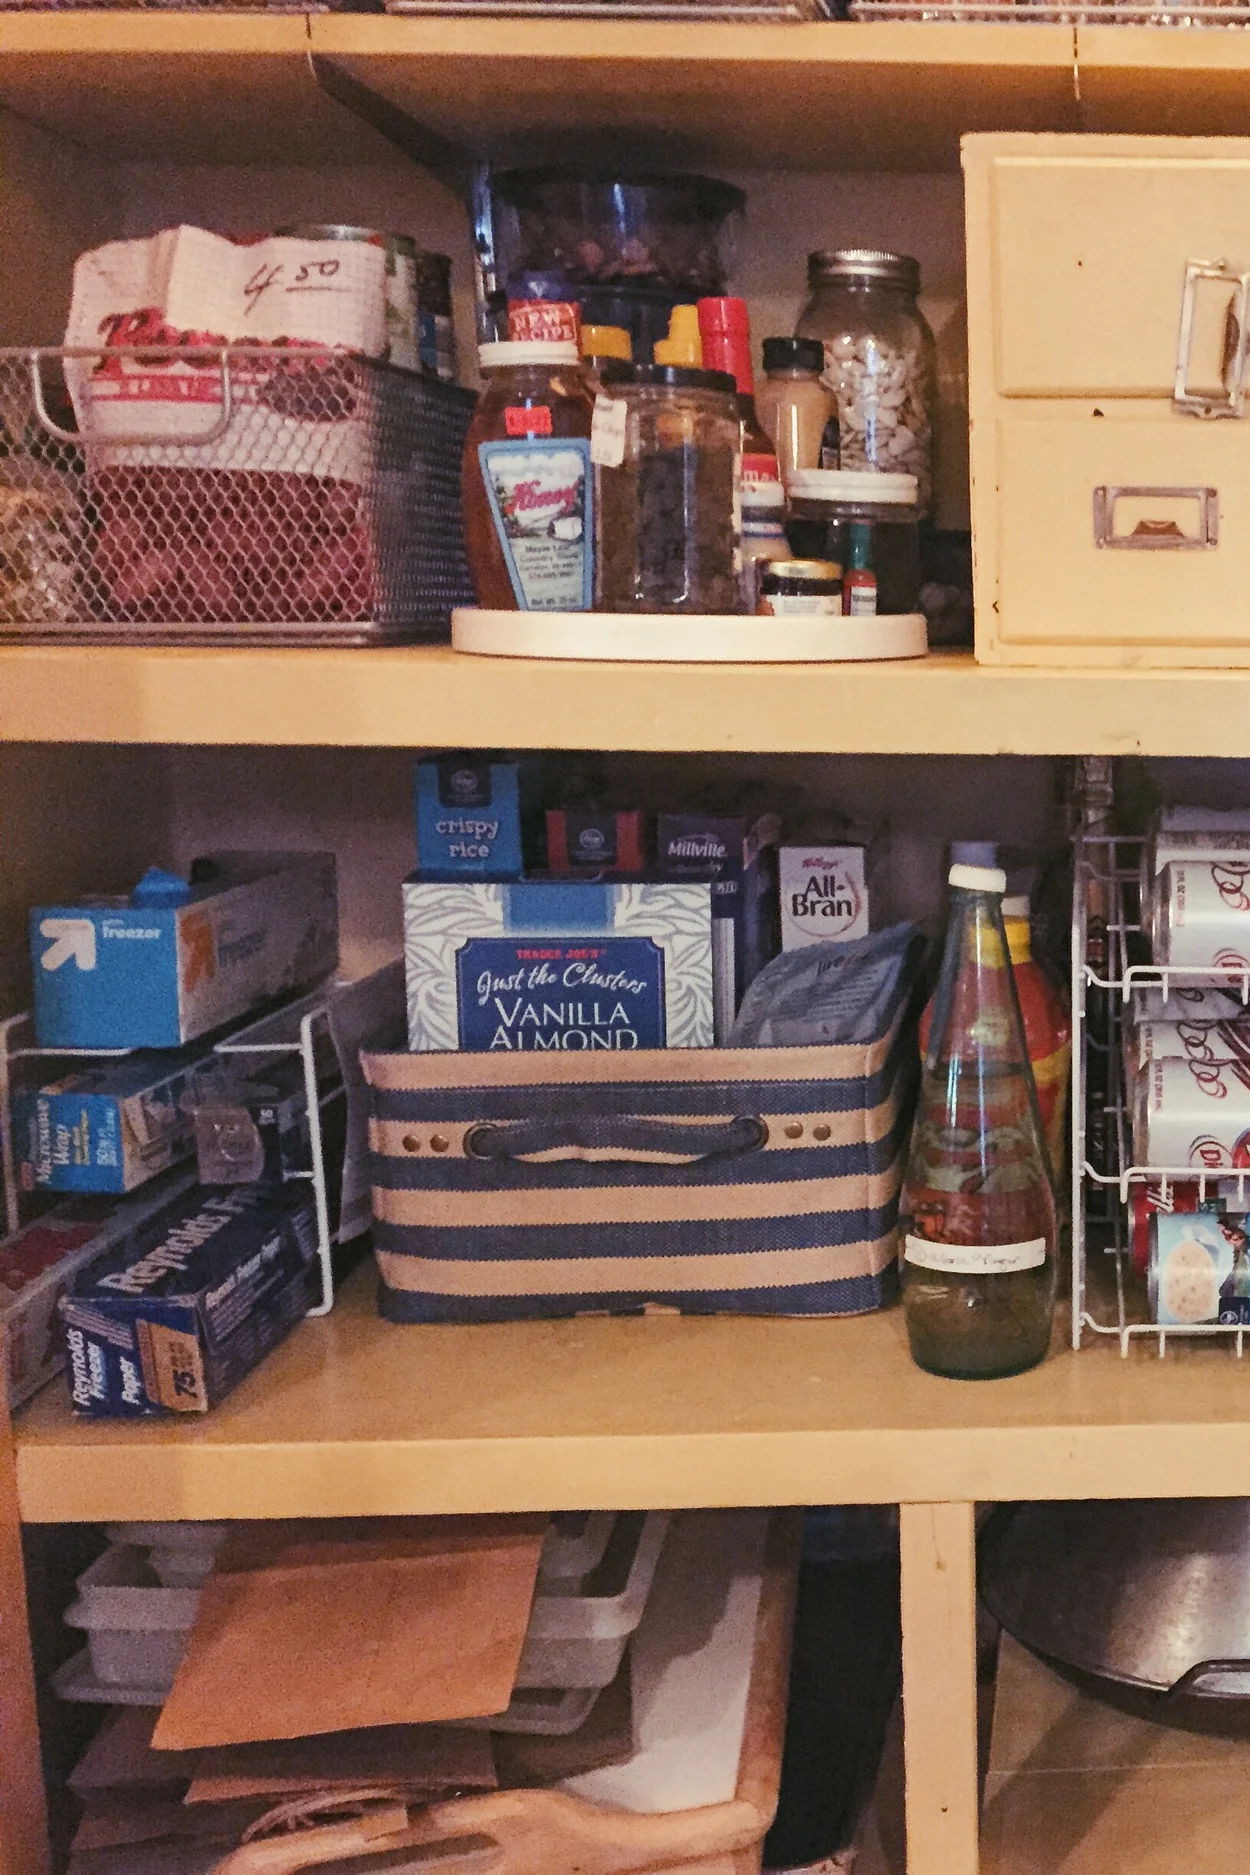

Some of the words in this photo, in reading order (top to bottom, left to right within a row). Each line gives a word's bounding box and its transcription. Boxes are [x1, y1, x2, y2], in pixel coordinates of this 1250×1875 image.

[435, 817, 499, 840] crispy
[450, 841, 490, 858] rice
[667, 838, 727, 858] Millville
[791, 893, 852, 917] Bran
[102, 925, 162, 940] freezer
[476, 966, 525, 1007] Just
[527, 961, 558, 990] the
[562, 961, 648, 995] Clusters
[494, 996, 631, 1028] VANILLA
[488, 1024, 639, 1051] ALMOND
[95, 1213, 232, 1294] Reynolds
[66, 1327, 92, 1407] Reynolds
[86, 1340, 109, 1400] Freezer
[119, 1355, 142, 1406] Paper
[171, 1369, 199, 1400] 75
